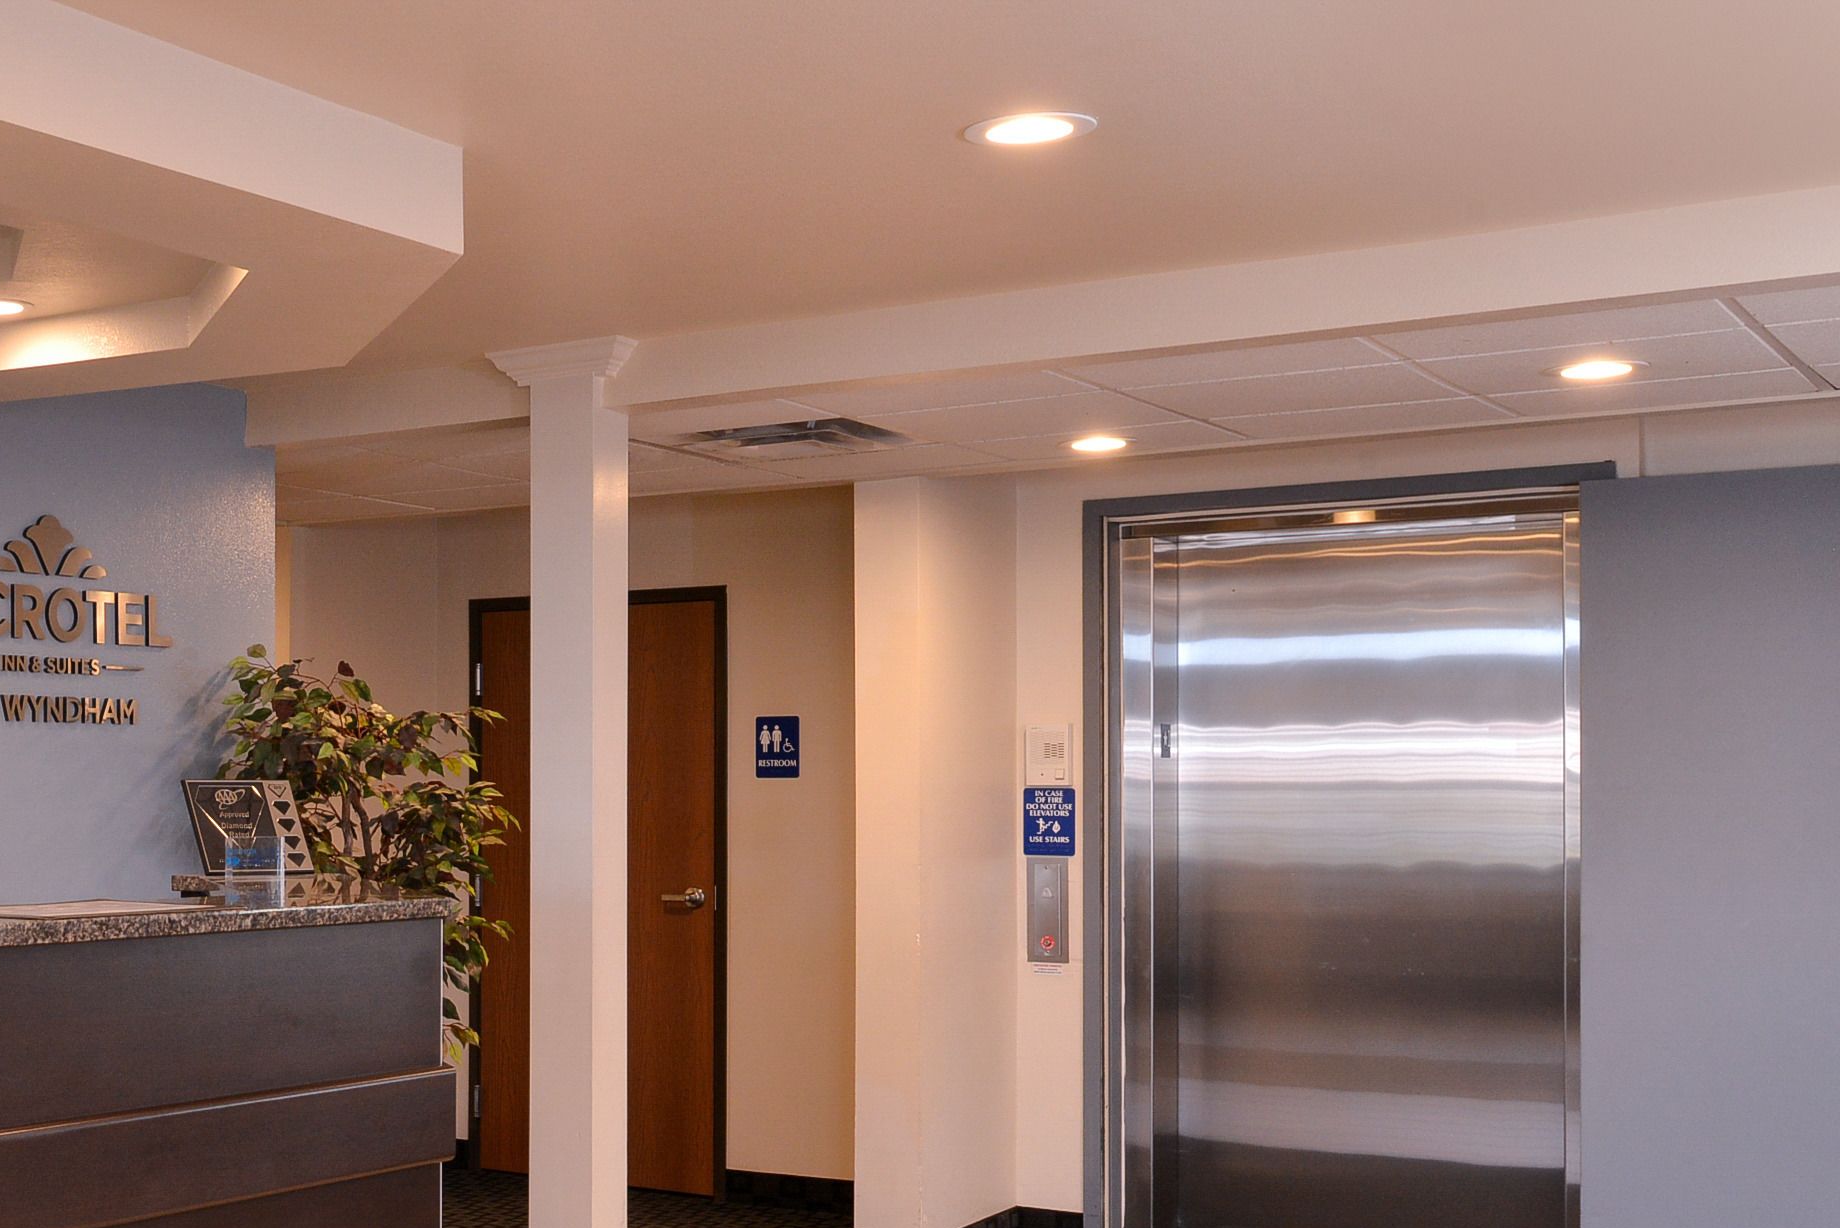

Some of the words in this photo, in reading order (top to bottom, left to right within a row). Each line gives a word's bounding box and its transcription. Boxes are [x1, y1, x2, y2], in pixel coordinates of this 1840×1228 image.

[28, 656, 41, 673] &
[43, 658, 101, 676] SUITES
[0, 694, 138, 725] WYNDHAM
[758, 759, 797, 767] RESTROOM
[219, 811, 250, 819] Approved
